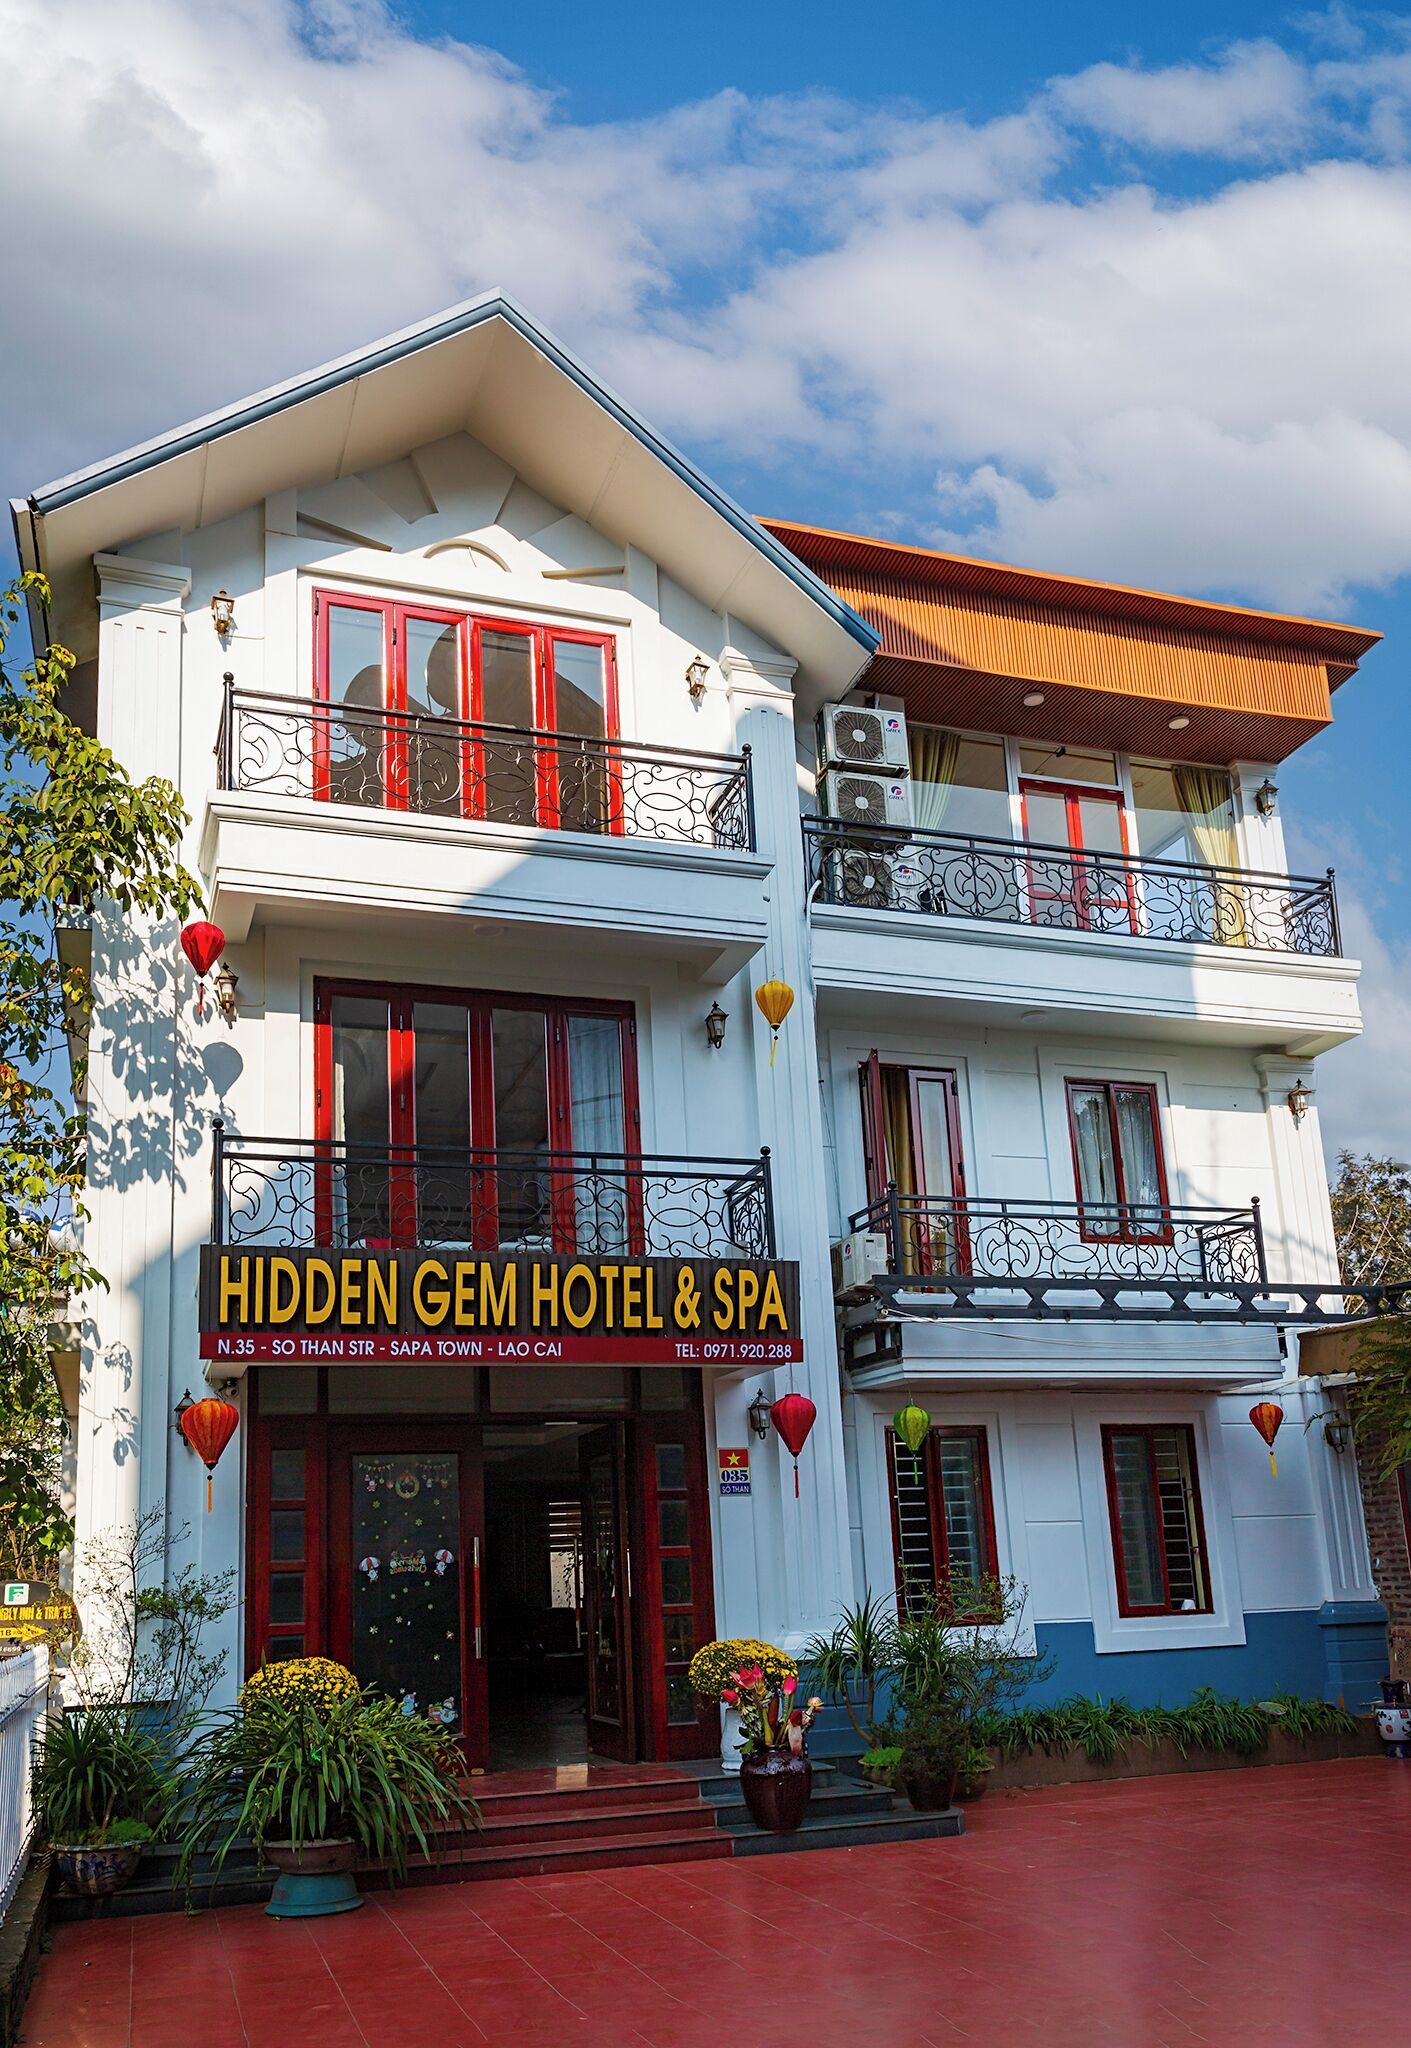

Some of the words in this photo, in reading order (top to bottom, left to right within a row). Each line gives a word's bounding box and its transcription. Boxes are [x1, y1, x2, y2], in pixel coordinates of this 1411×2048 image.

[219, 1256, 398, 1325] HIDDEN
[412, 1259, 517, 1327] GEM
[532, 1264, 663, 1329] HOTEL
[673, 1267, 701, 1329] &
[713, 1268, 788, 1331] SPA
[217, 1339, 255, 1355] N.35
[271, 1339, 296, 1355] SO
[300, 1340, 344, 1355] THAN
[348, 1340, 375, 1355] STR
[390, 1340, 433, 1356] SAPA
[436, 1341, 482, 1356] TOWN
[498, 1341, 530, 1357] LAO
[534, 1342, 562, 1357] CAI
[675, 1343, 700, 1358] TEL:
[703, 1343, 792, 1358] 0971.920.288
[721, 1470, 749, 1482] 035
